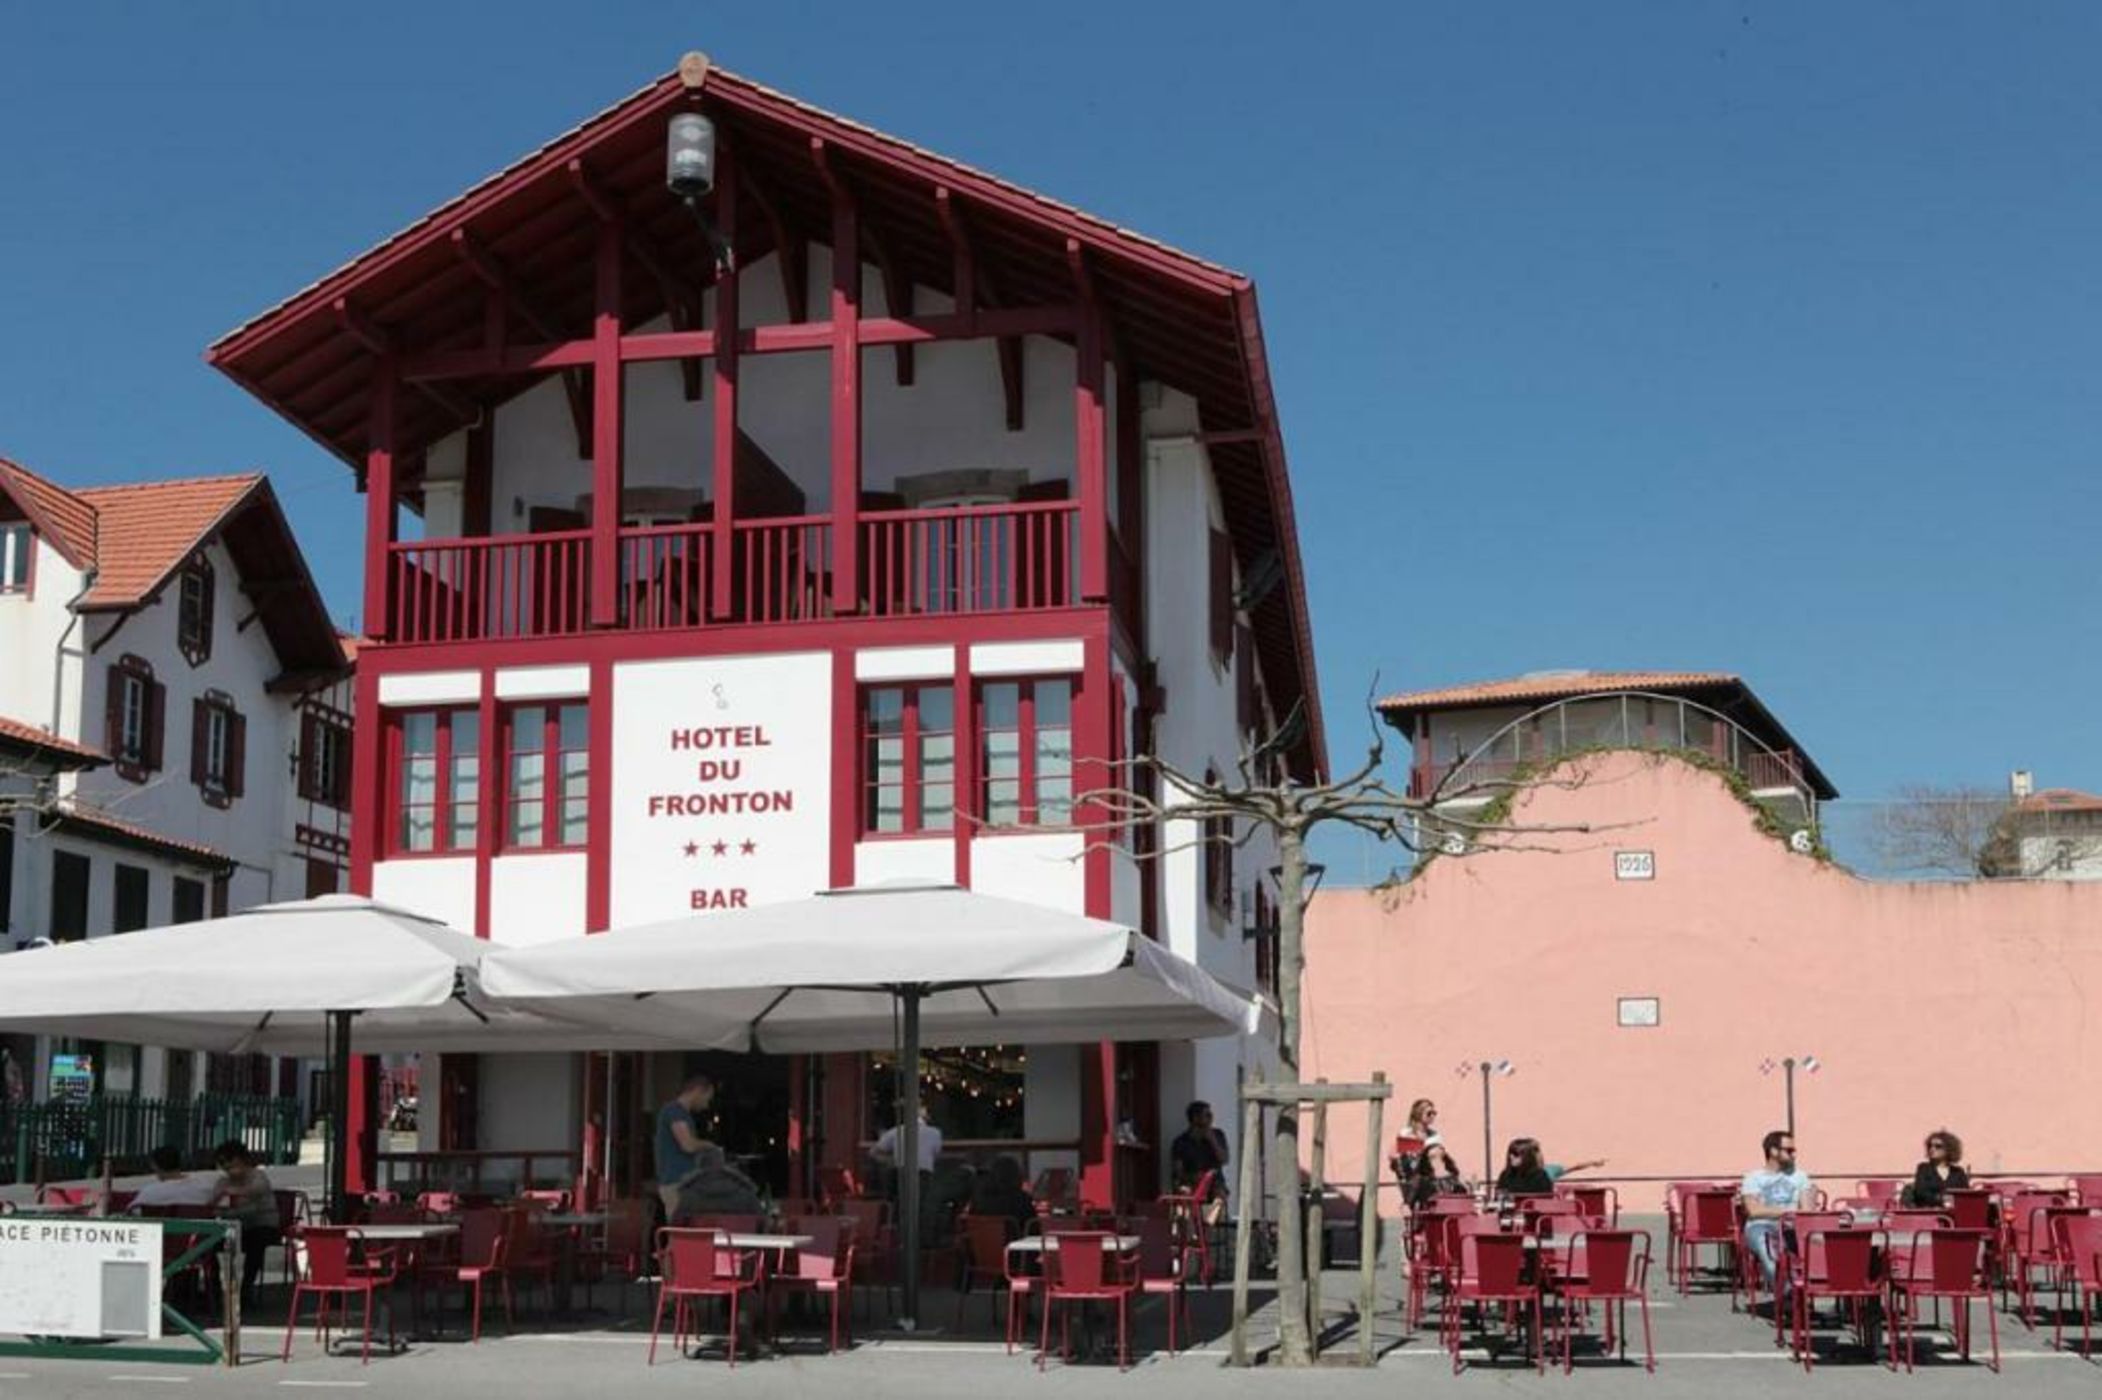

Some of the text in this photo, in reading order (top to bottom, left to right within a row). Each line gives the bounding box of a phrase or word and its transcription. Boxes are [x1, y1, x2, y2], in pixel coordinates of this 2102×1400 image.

[671, 726, 771, 750] HOTEL
[699, 760, 740, 782] DU
[649, 790, 793, 817] FRONTON
[690, 888, 748, 910] BAR
[40, 1223, 141, 1245] PIÉTONNE
